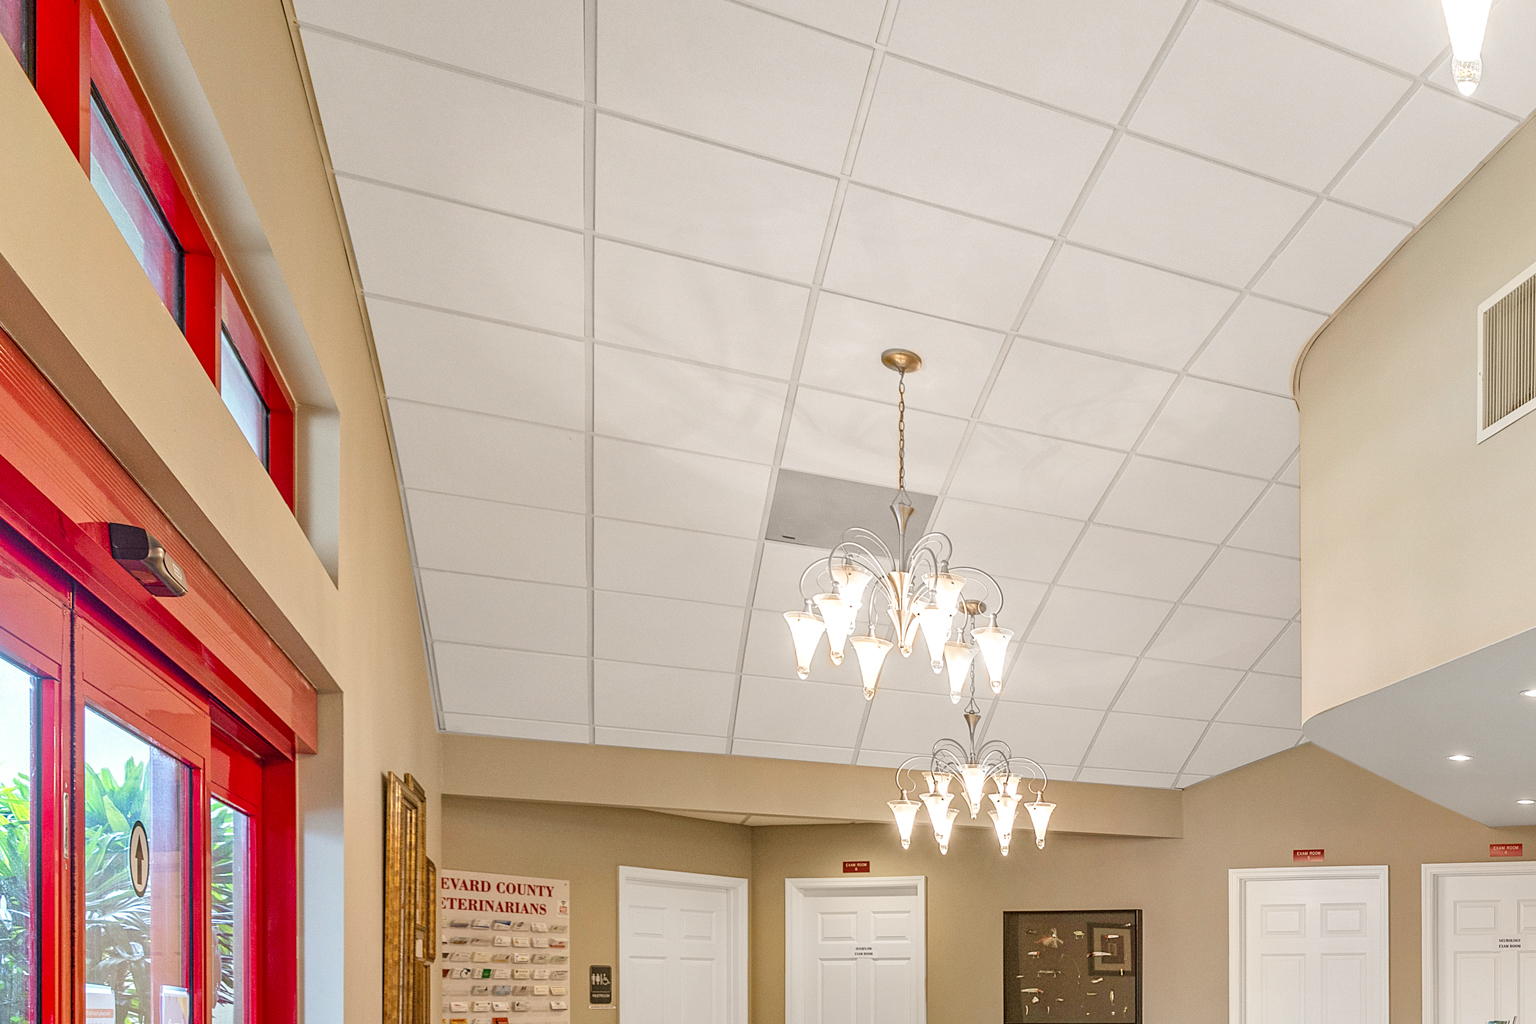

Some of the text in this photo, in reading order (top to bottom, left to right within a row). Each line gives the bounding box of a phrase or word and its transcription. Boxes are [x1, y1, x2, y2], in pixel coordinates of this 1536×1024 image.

[441, 877, 554, 898] EVARD COUNTY
[441, 897, 547, 915] ETERINARIANS
